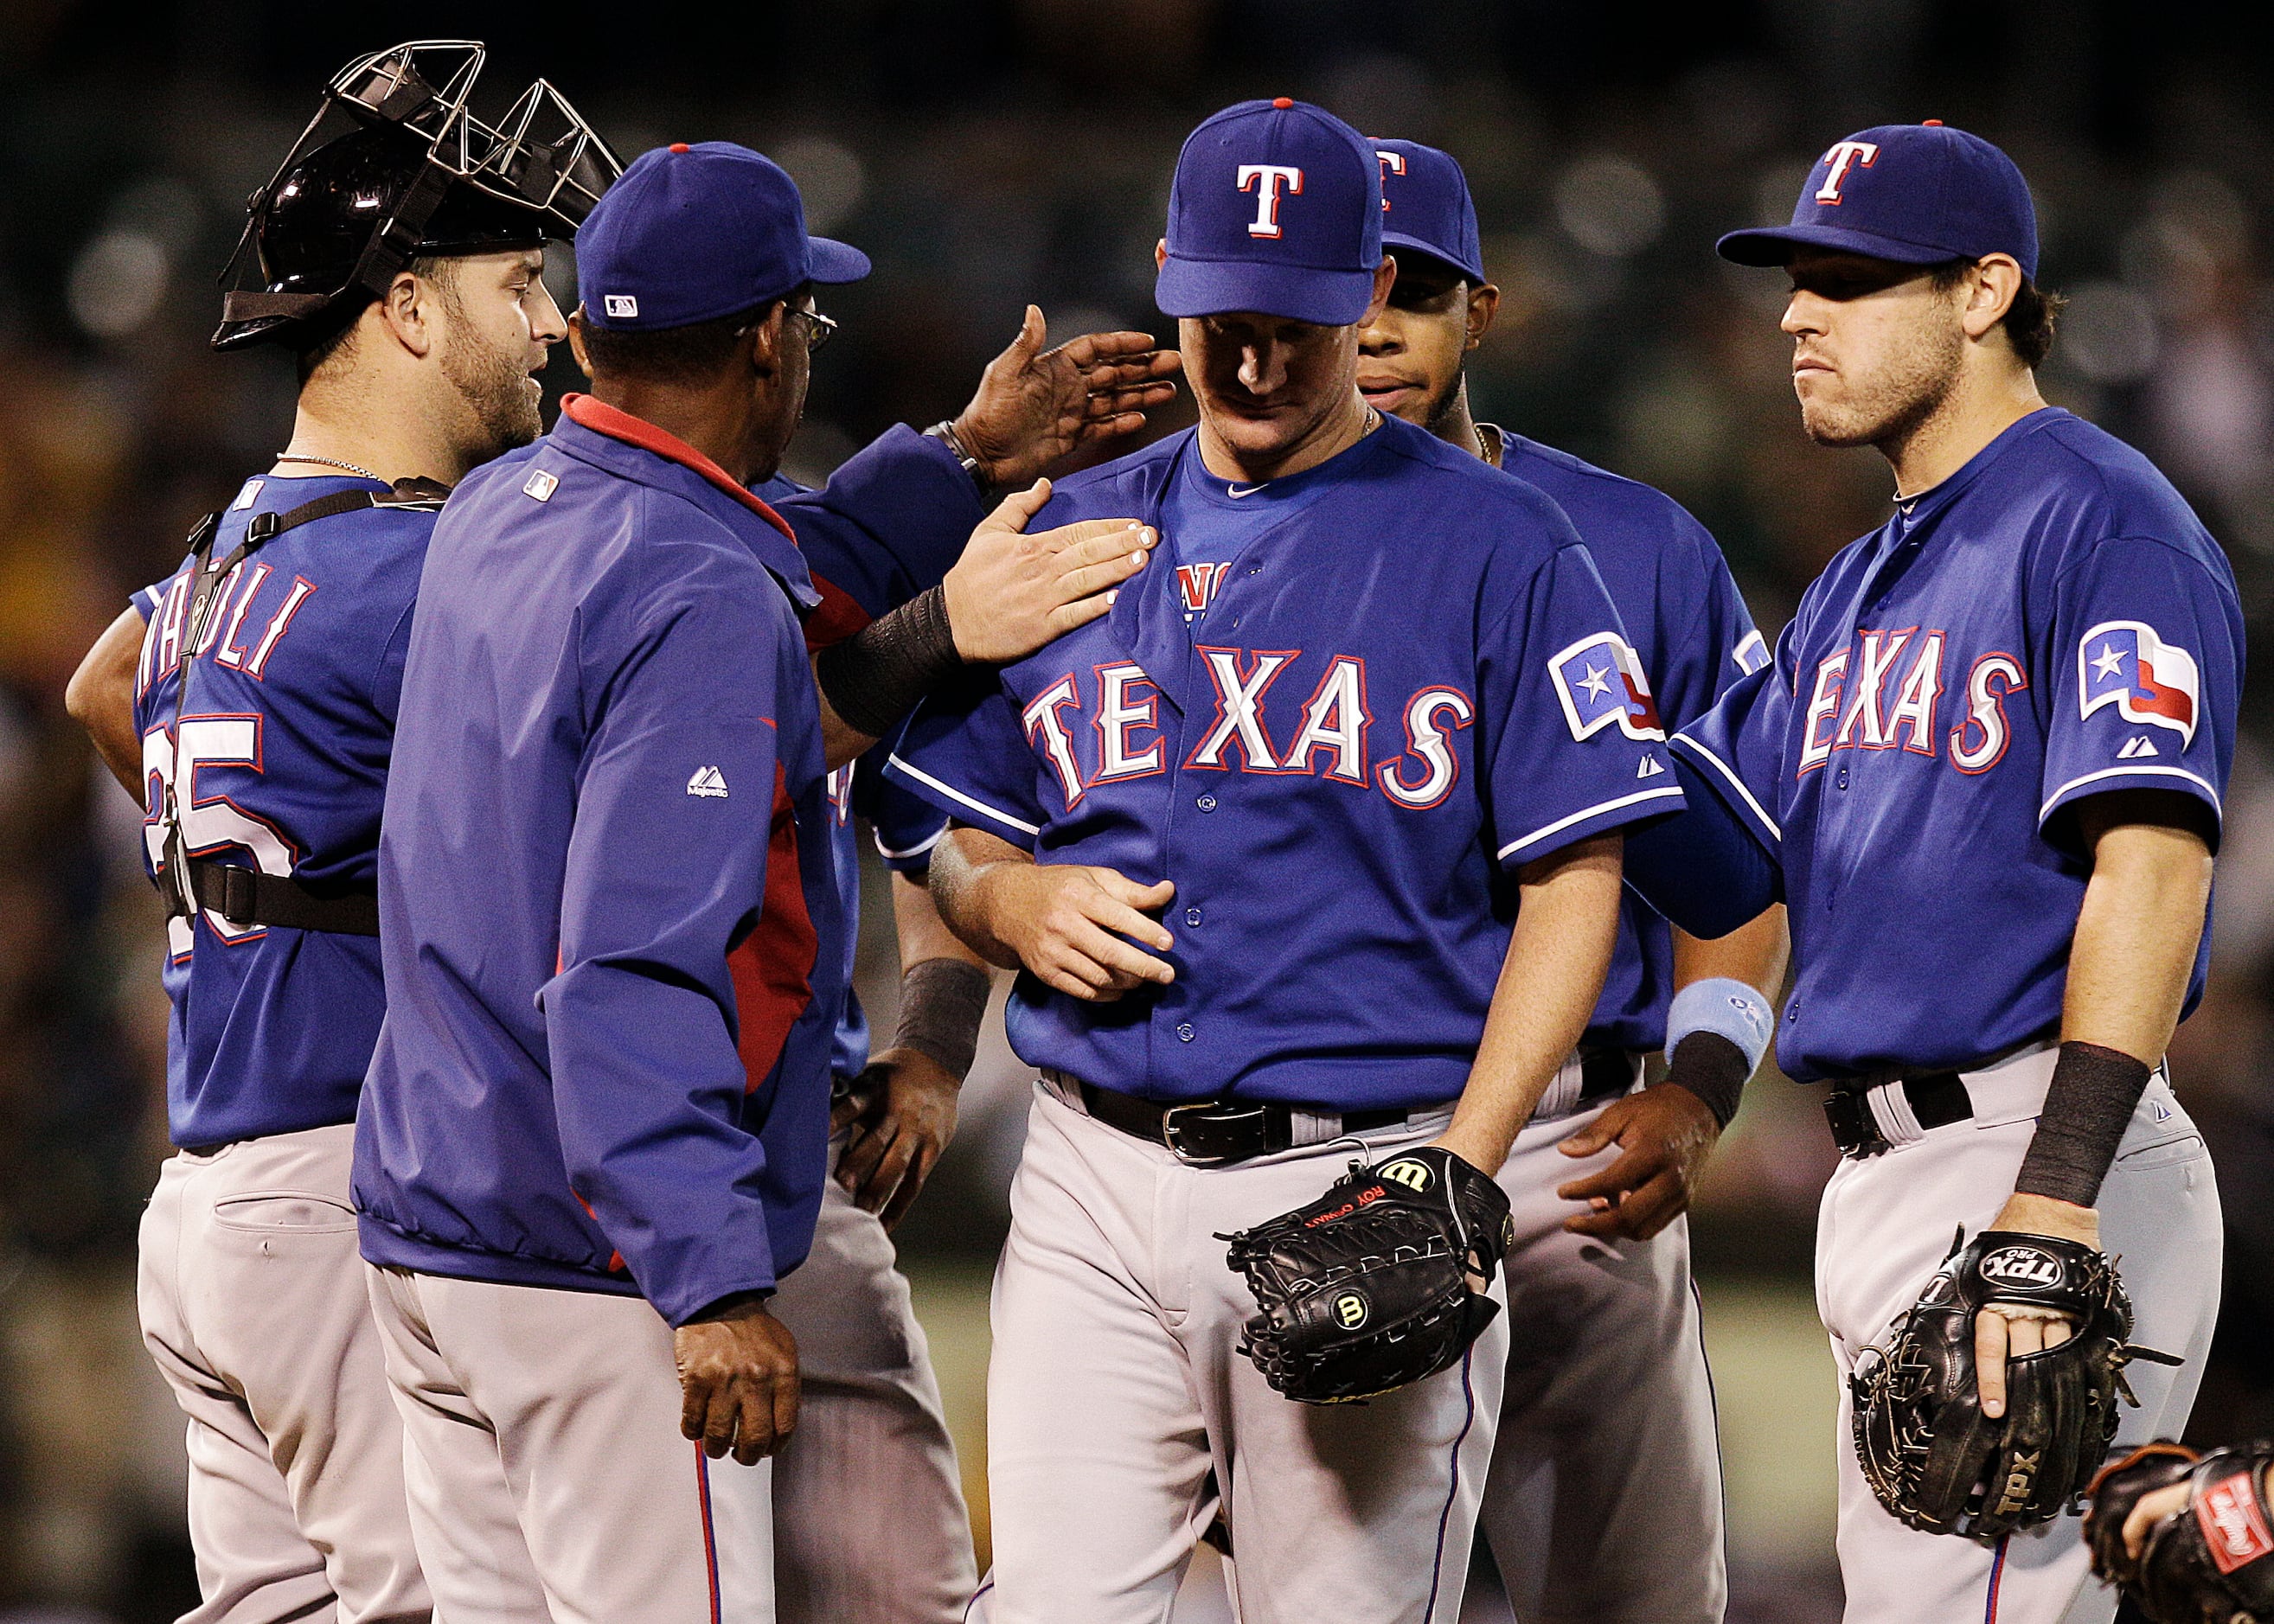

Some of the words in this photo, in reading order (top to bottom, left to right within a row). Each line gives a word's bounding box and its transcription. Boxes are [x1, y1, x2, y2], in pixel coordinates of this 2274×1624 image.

[1236, 164, 1305, 240] T
[1815, 141, 1881, 206] T
[138, 556, 317, 706] NAOLI
[1022, 644, 1476, 812] TEXAS
[1796, 626, 2030, 779] EXAS
[1356, 1186, 1387, 1205] ROY
[1986, 1256, 2055, 1283] TPX
[2006, 1249, 2039, 1260] PRO
[1994, 1450, 2040, 1515] TPX
